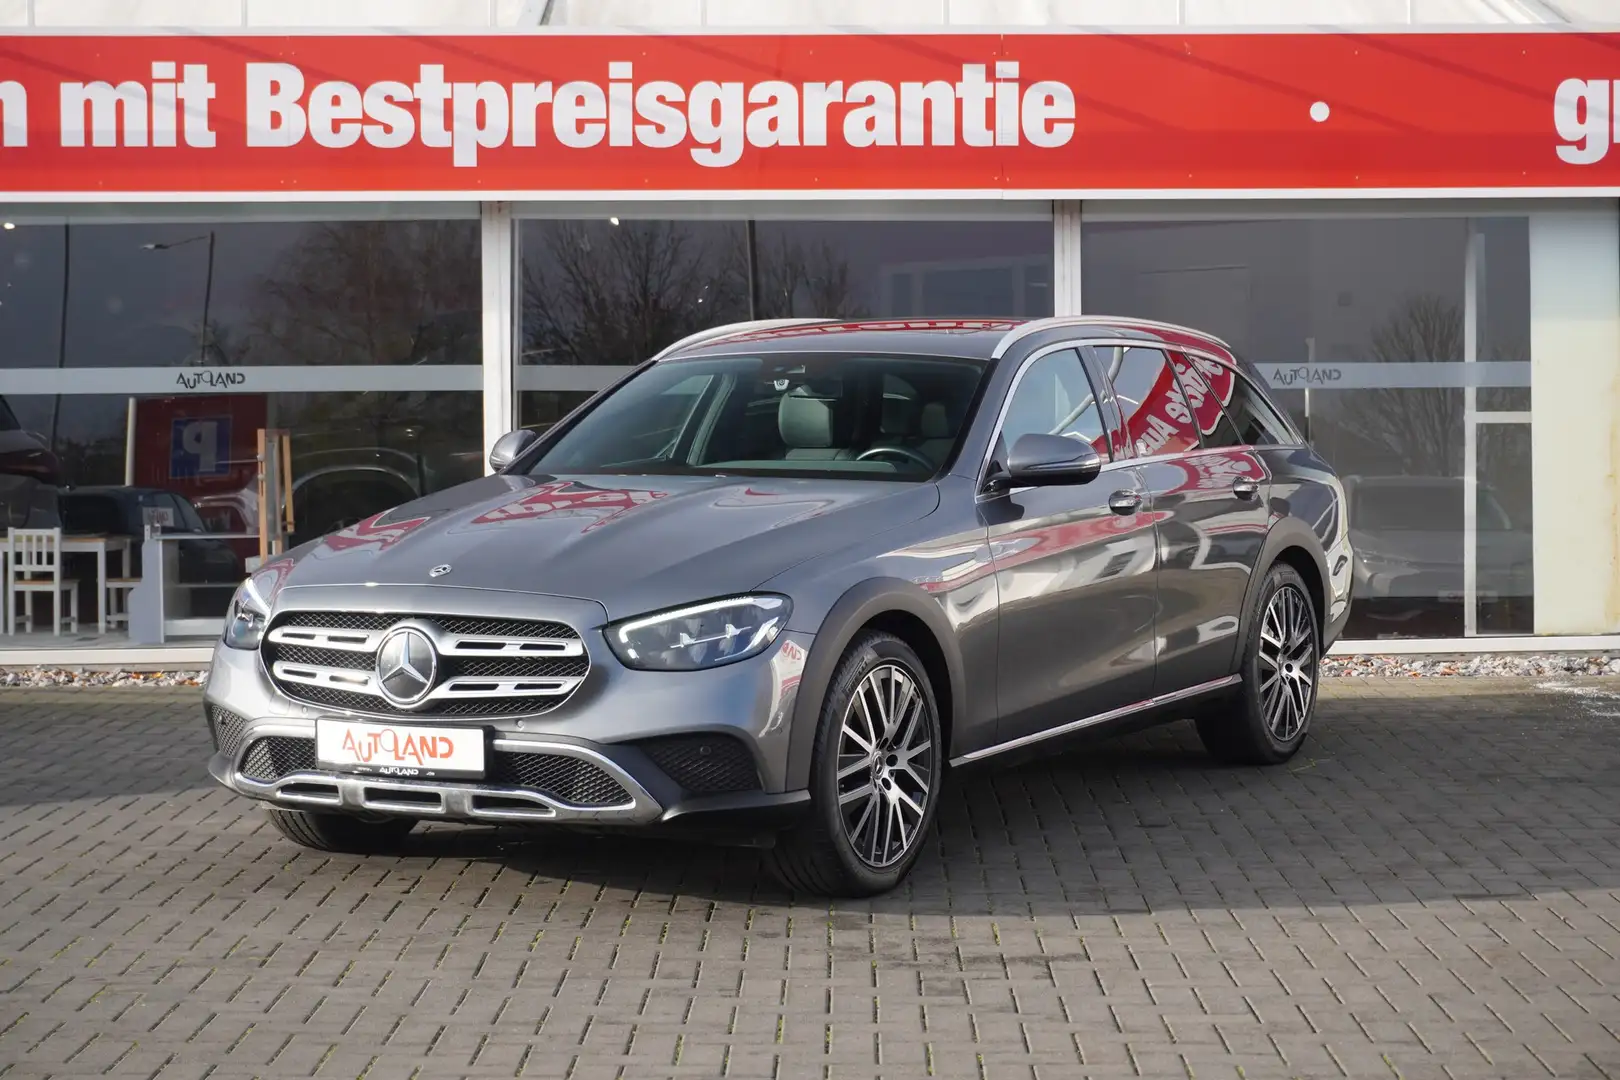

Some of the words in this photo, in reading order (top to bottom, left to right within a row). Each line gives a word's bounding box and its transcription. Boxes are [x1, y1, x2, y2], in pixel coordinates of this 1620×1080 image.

[61, 61, 216, 148] mit
[246, 61, 1076, 167] Bestpreisgarantie
[176, 370, 246, 389] AUTOLAND
[1273, 366, 1342, 386] AUTOLAND
[342, 728, 454, 766] AUTOLAND
[379, 766, 419, 776] AUTOLAND
